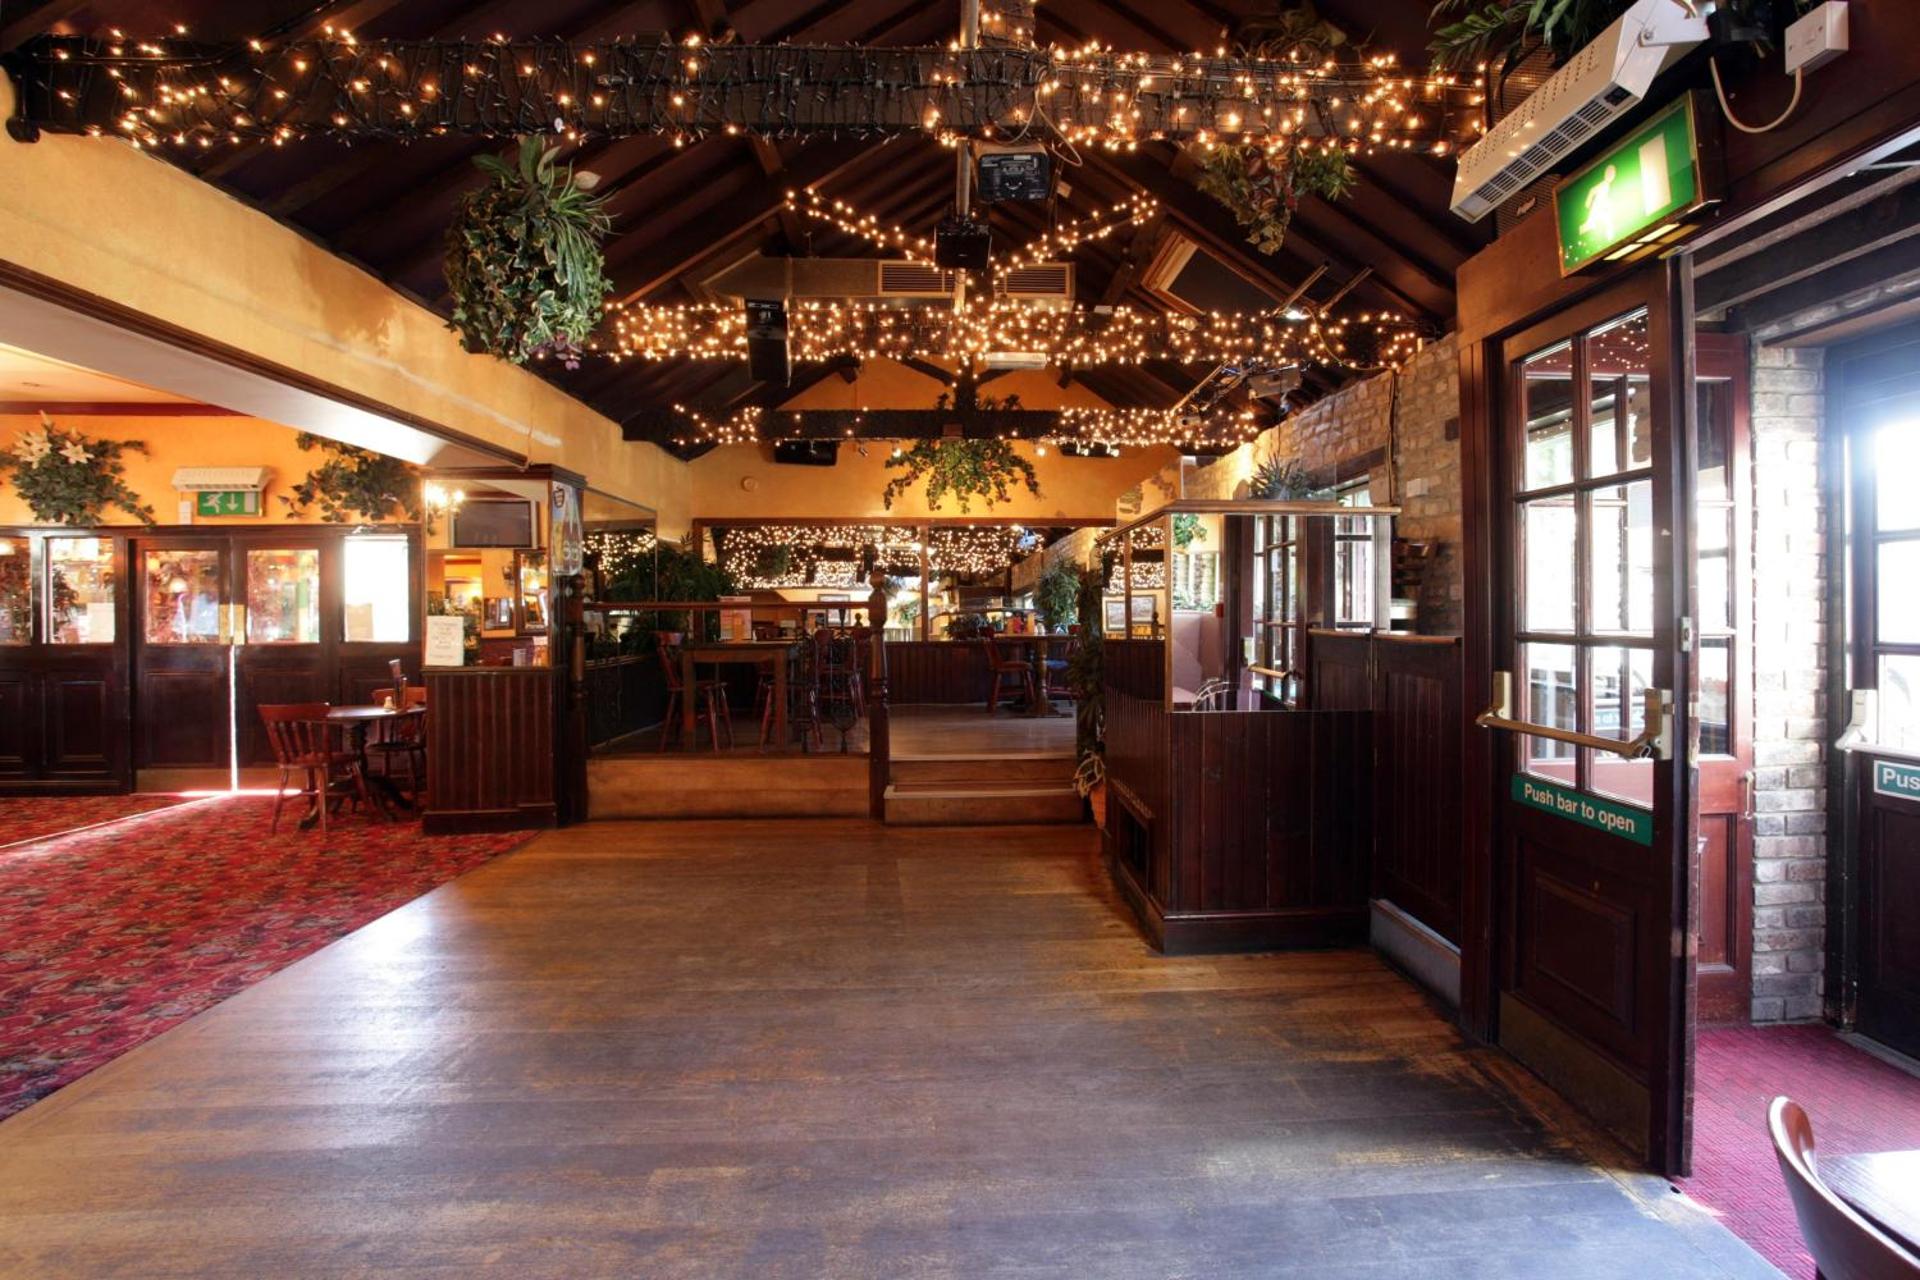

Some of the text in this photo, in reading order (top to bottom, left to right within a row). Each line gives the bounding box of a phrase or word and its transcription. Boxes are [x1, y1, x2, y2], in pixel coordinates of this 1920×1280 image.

[1524, 783, 1636, 834] Push bar to open
